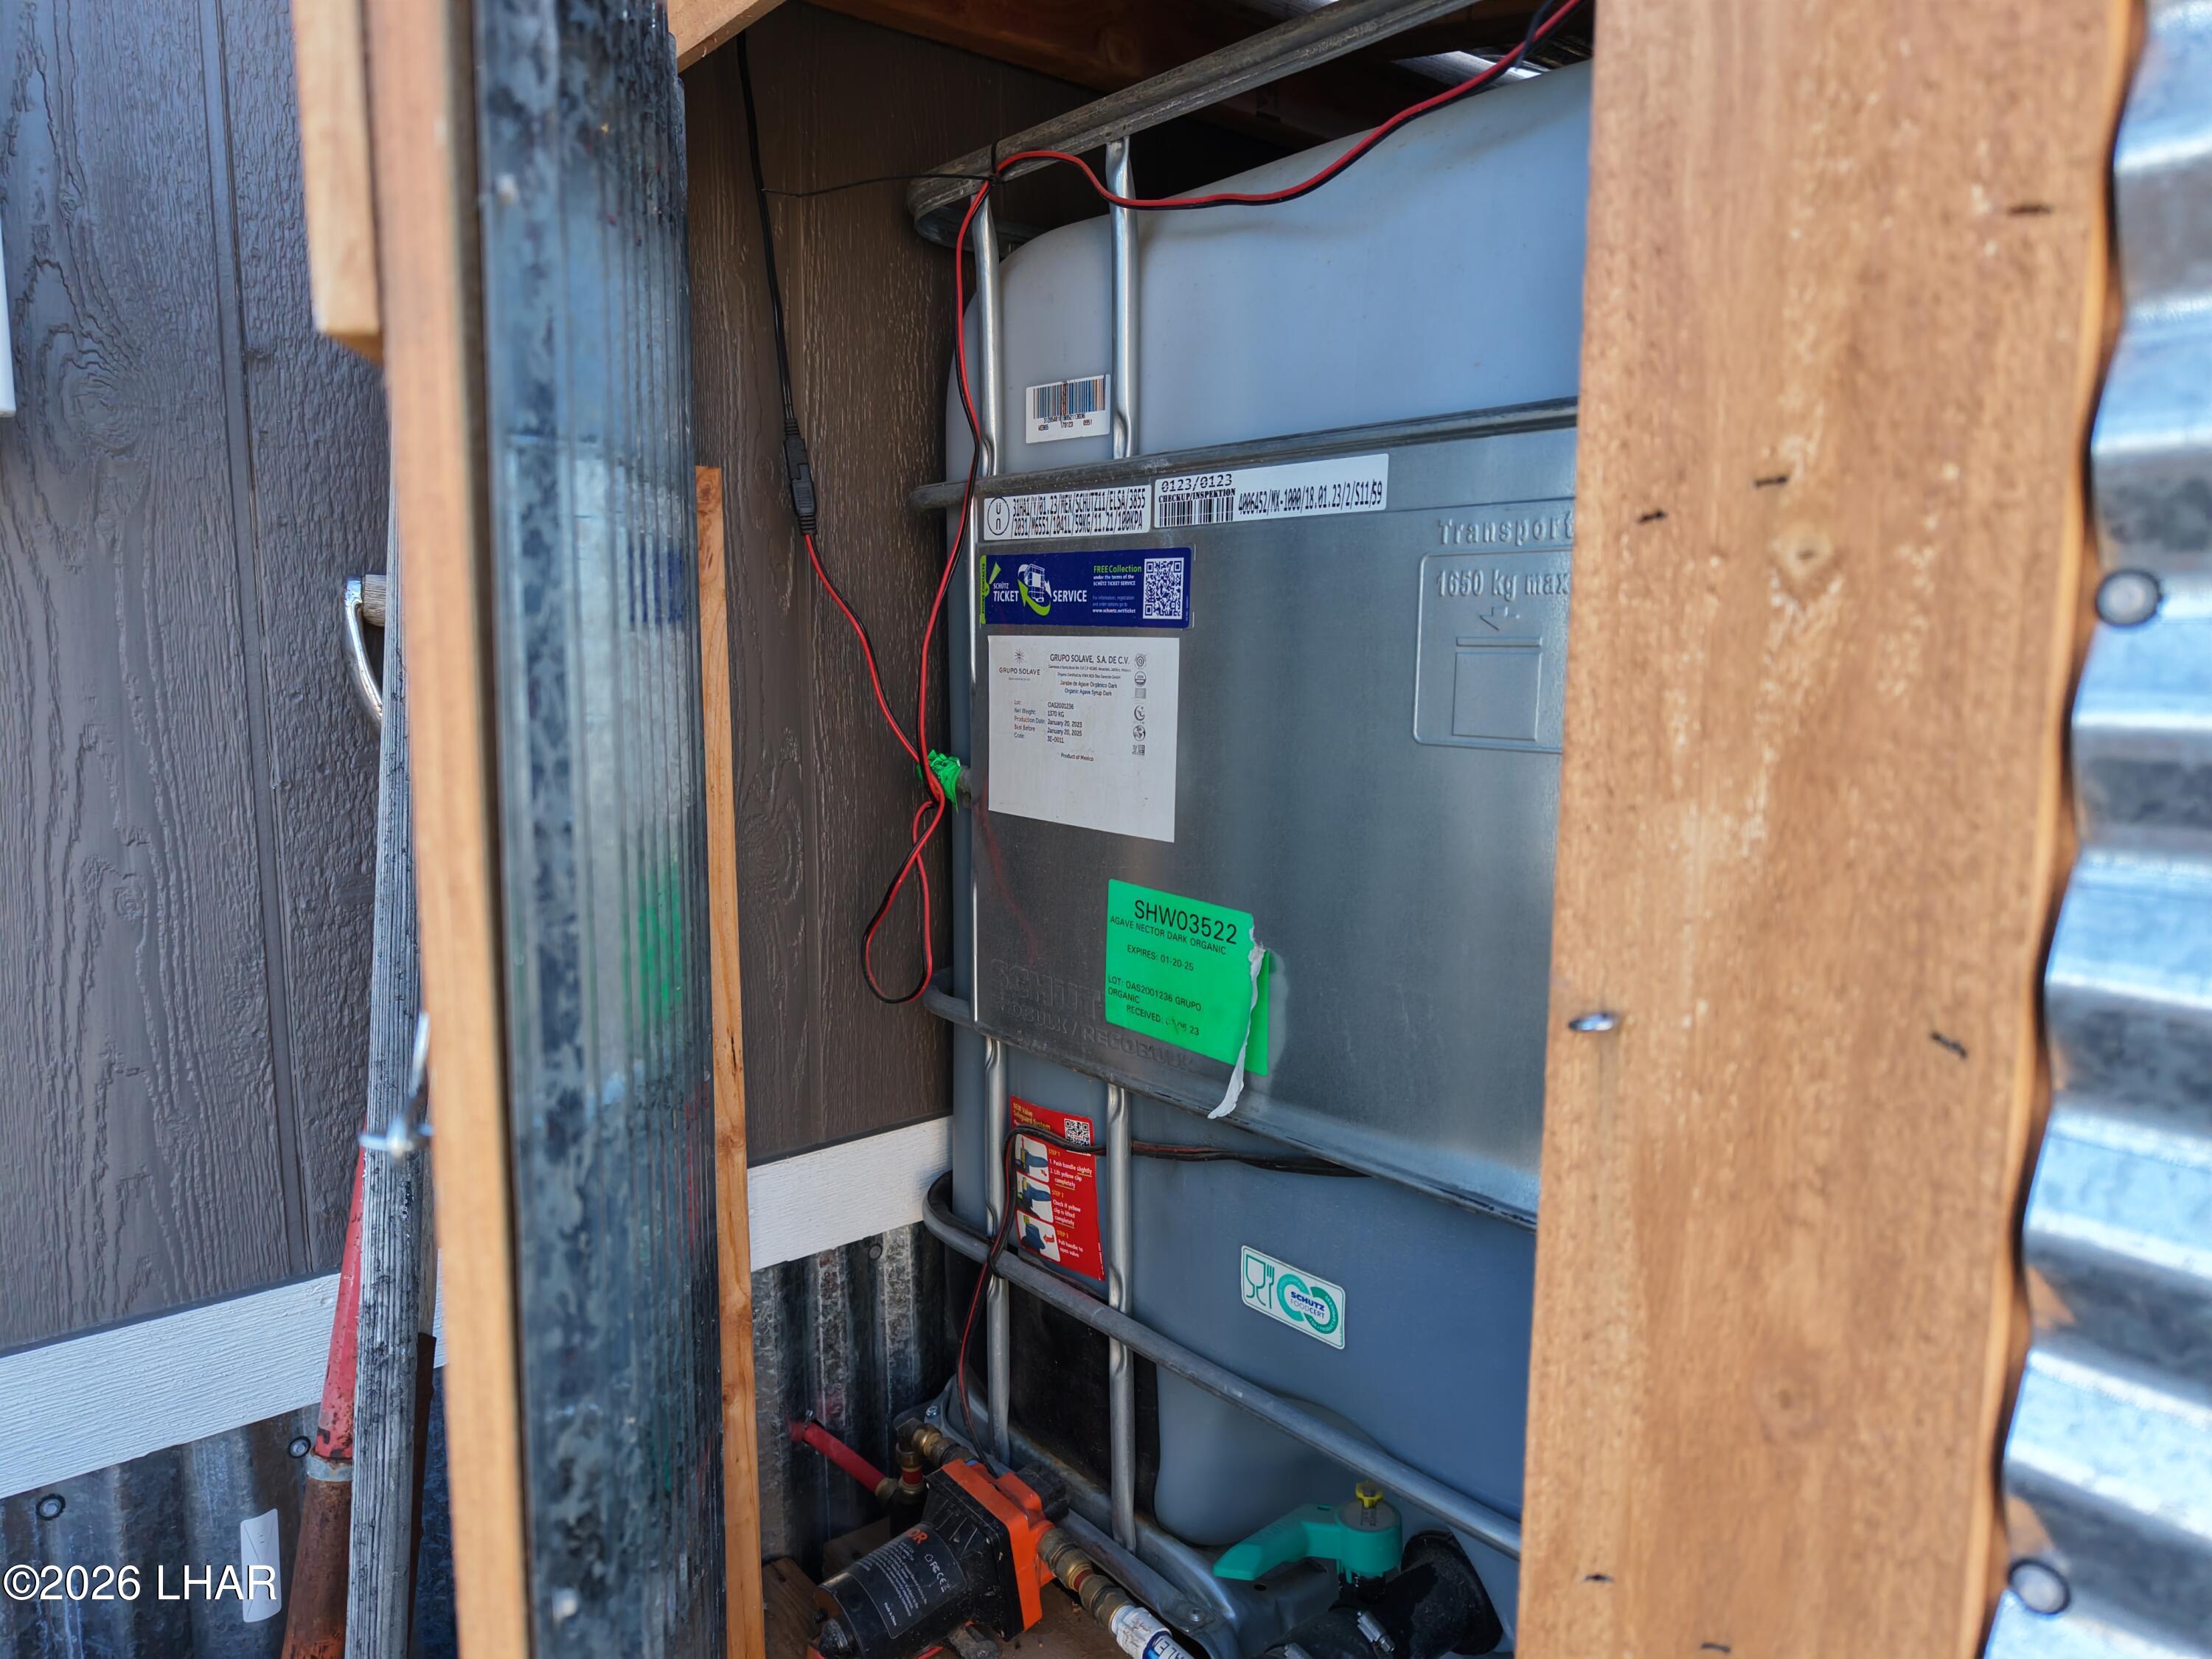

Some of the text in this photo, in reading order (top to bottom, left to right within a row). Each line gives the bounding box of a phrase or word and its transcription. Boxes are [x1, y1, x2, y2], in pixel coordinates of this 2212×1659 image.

[1161, 473, 1233, 493] 0123/0123
[1158, 488, 1236, 503] CHECKUP/INSPEKTION
[1439, 512, 1573, 546] Transport
[1109, 564, 1142, 573] Collection
[993, 581, 1009, 589] SCHÜTZ
[1437, 568, 1571, 602] 1650 kg max
[993, 590, 1088, 602] TICKET SERVICE
[1050, 654, 1070, 662] GRUPO
[1097, 655, 1107, 664] S.A.
[1047, 719, 1063, 727] January
[1047, 727, 1063, 735] January
[1134, 900, 1237, 945] SHW03522
[1110, 916, 1226, 955] AGAVE NECTOR DARK ORGANIC
[1127, 945, 1194, 972] EXPIRES: 01-20-25
[1108, 975, 1124, 986] LOT:
[1175, 997, 1202, 1011] GRUPO
[1108, 987, 1140, 1004] ORGANIC
[1022, 1106, 1032, 1116] Valve
[1033, 1119, 1051, 1130] System
[1062, 1162, 1076, 1170] handle
[1077, 1166, 1092, 1175] slightly
[1054, 1178, 1075, 1189] completely
[1053, 1199, 1063, 1208] Check
[1068, 1205, 1081, 1213] yellow
[1065, 1210, 1075, 1219] lifted
[1054, 1215, 1074, 1227] completely
[1057, 1229, 1065, 1237] STEP
[1066, 1241, 1078, 1251] handle
[1069, 1250, 1079, 1258] valve
[1290, 1298, 1325, 1319] FOODCERT
